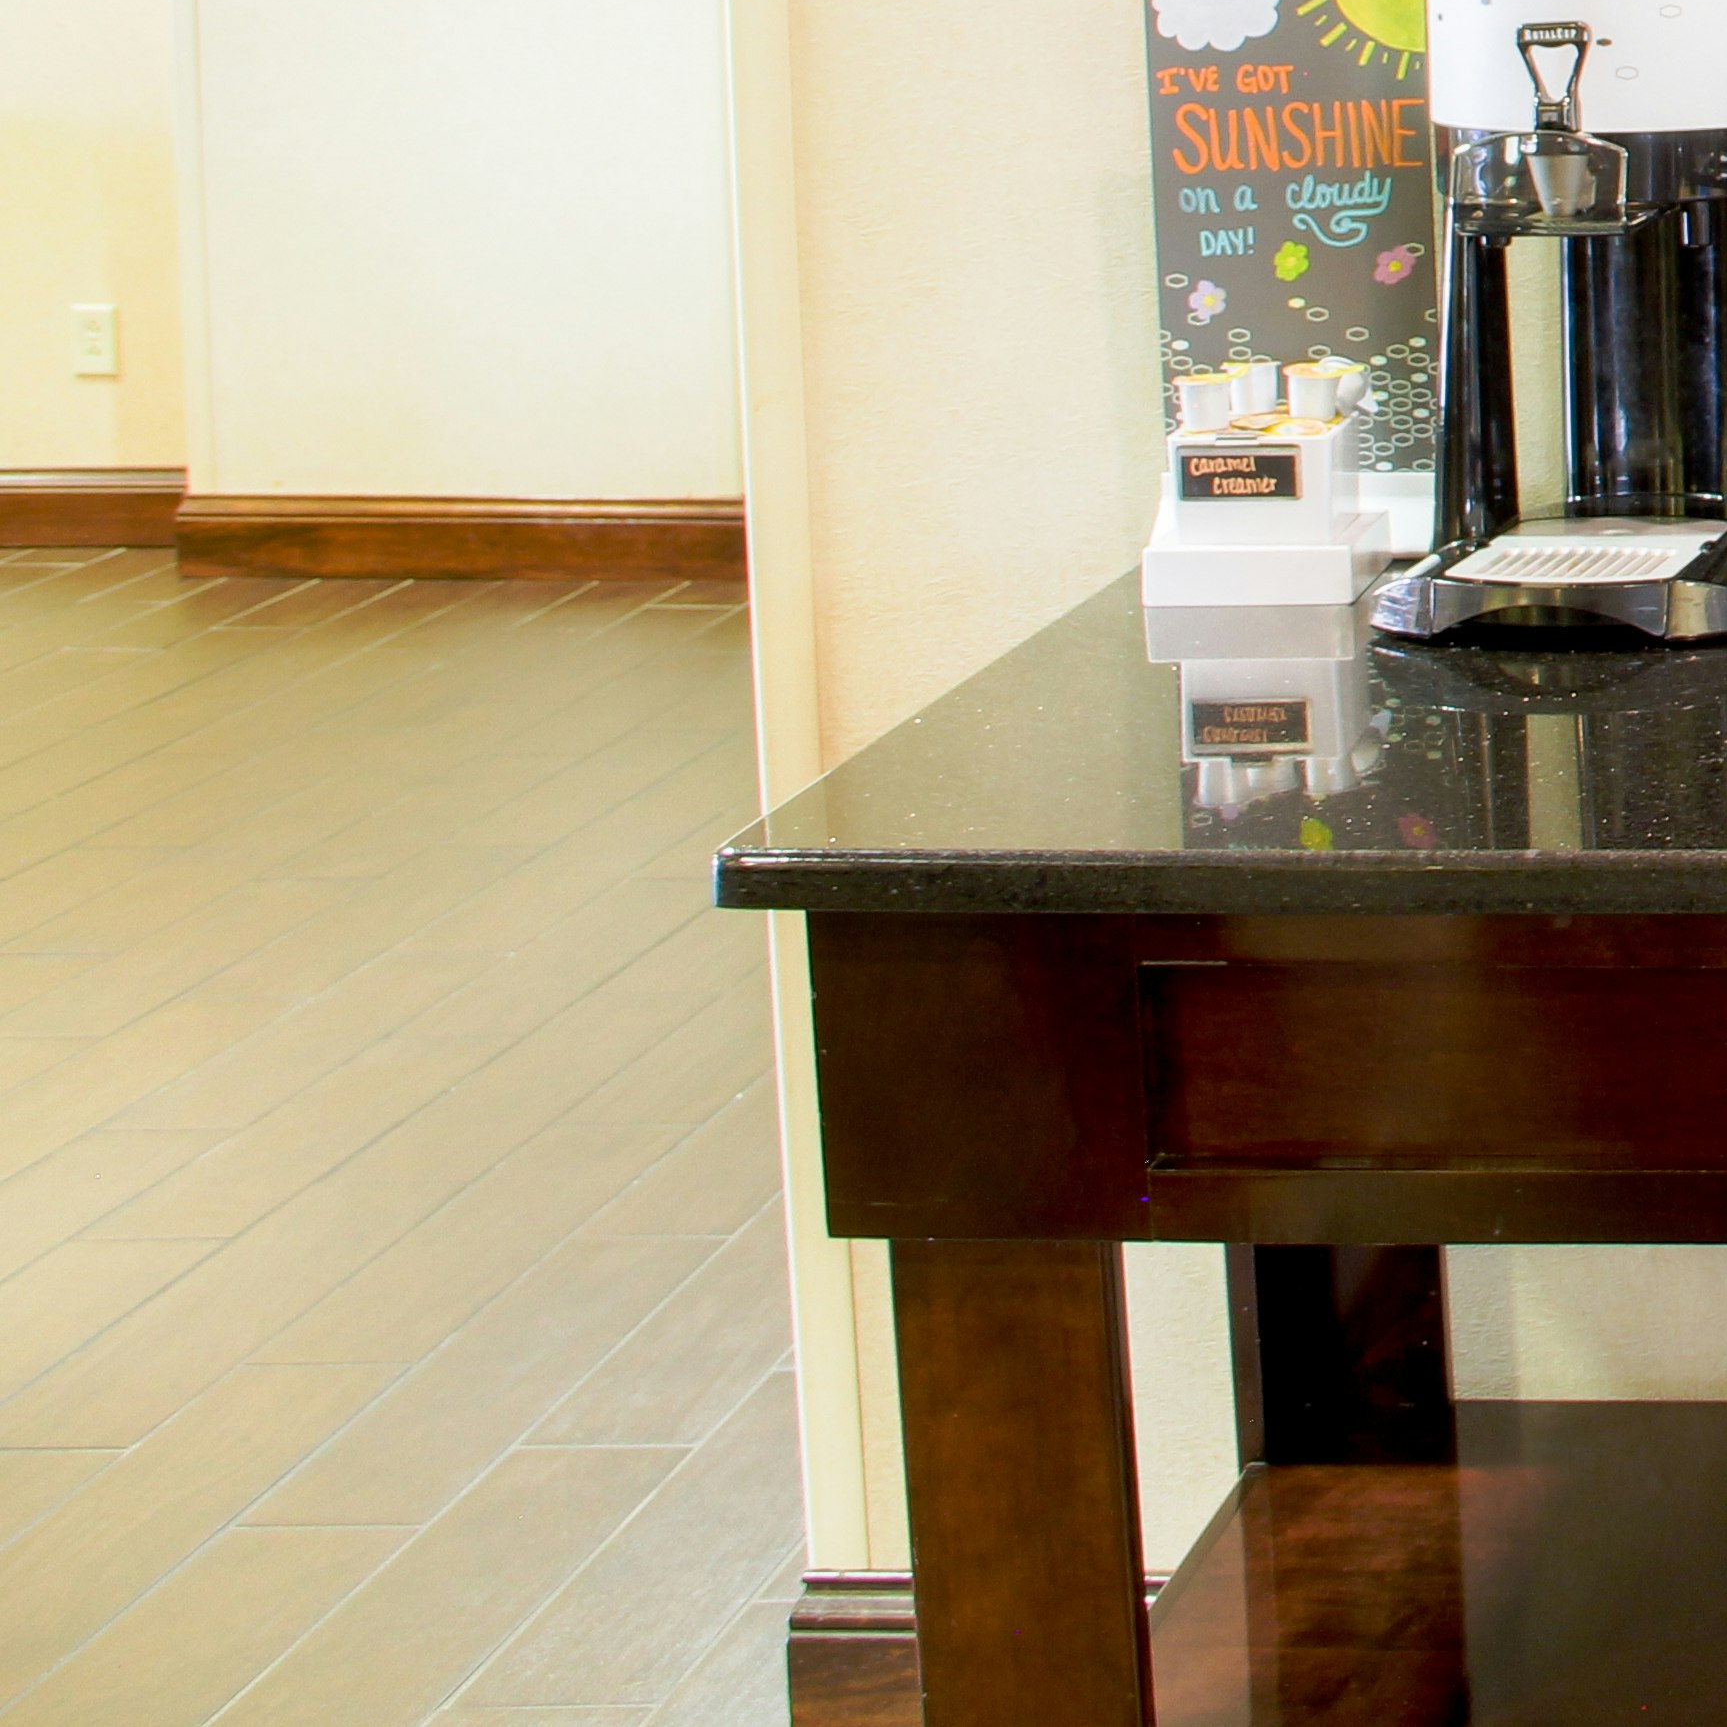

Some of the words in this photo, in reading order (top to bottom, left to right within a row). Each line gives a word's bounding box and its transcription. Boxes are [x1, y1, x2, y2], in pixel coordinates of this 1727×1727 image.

[1155, 65, 1221, 95] I'VE
[1235, 64, 1294, 94] GOT
[1172, 99, 1425, 174] SUNSHINE
[1178, 186, 1222, 214] on
[1233, 184, 1259, 212] a
[1285, 169, 1393, 231] cloudy
[1200, 227, 1256, 257] DAY!
